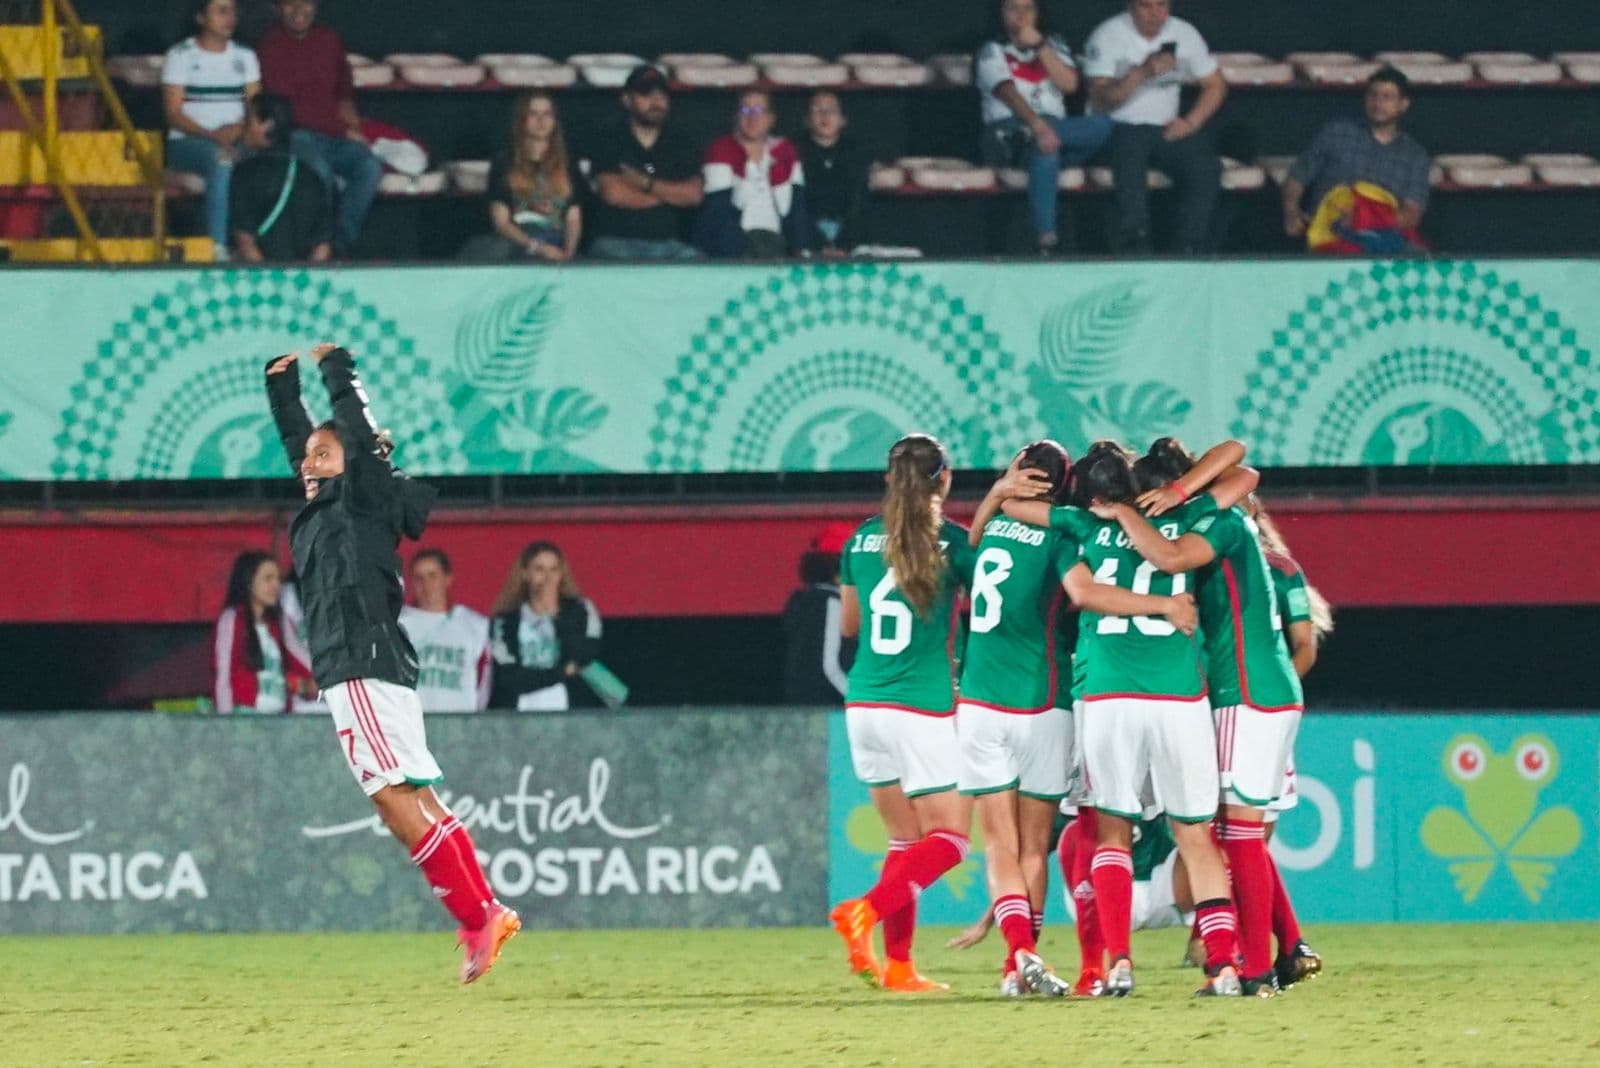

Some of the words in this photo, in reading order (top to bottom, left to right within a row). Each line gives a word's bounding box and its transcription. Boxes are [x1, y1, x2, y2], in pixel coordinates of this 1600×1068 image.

[869, 566, 913, 655] 6
[970, 547, 1014, 633] 8
[1093, 558, 1187, 636] 10
[338, 728, 357, 765] 7
[69, 851, 208, 900] RICA
[477, 847, 640, 898] OSTA
[647, 845, 782, 894] RICA
